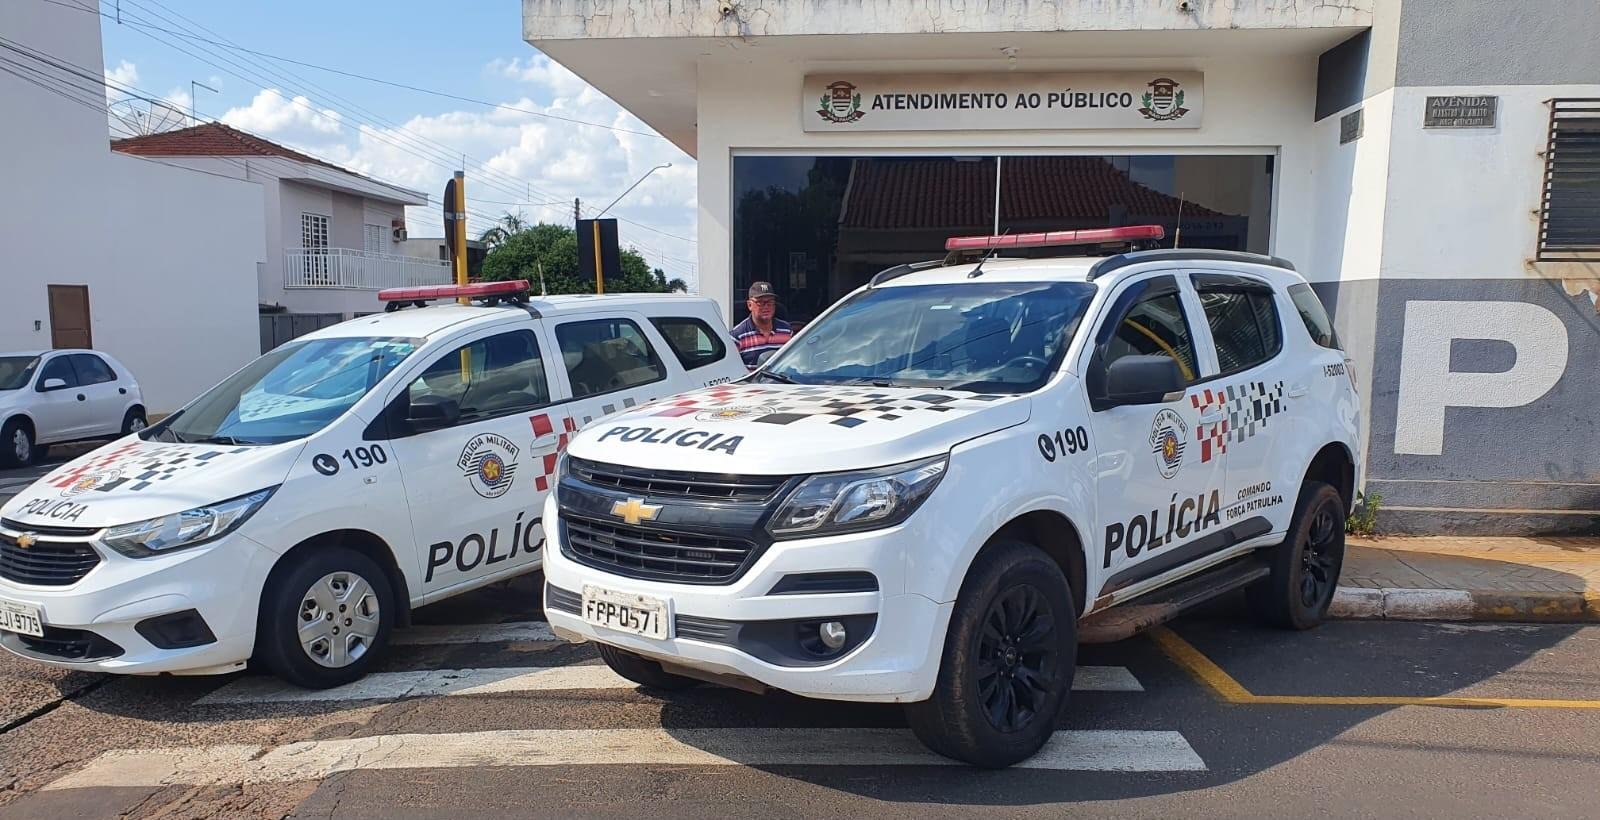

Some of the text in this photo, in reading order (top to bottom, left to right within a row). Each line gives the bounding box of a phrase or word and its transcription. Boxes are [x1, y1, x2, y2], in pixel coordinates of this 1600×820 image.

[871, 88, 1133, 110] ATENDIMENTO AO PÚBLICO
[1432, 97, 1488, 107] AVENIDA
[1394, 300, 1569, 456] P
[486, 436, 516, 456] MILITAR
[597, 425, 745, 456] POLÍCIA
[1054, 425, 1089, 457] 190
[342, 444, 388, 470] 190
[1237, 481, 1271, 500] COMANDO
[16, 498, 88, 522] POLÍCIA
[1226, 495, 1283, 521] FORÇA PATRULHA
[1103, 488, 1220, 570] POLÍCIA
